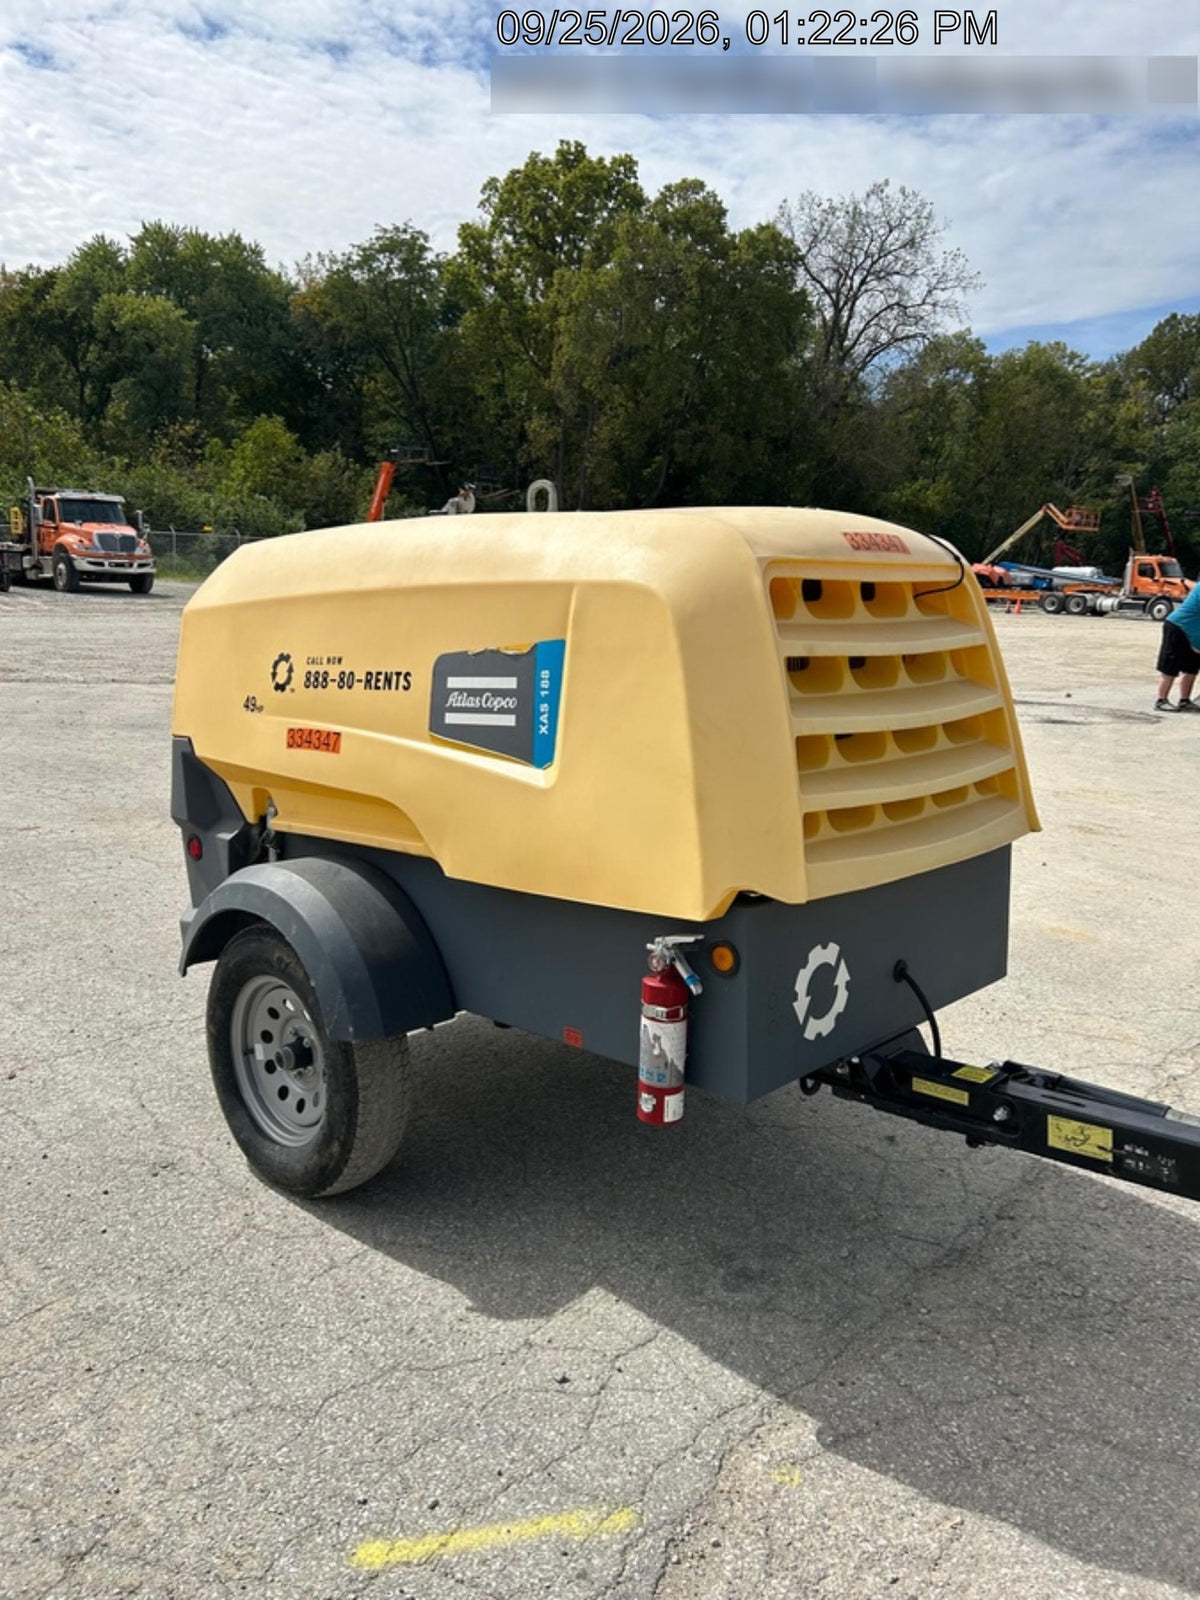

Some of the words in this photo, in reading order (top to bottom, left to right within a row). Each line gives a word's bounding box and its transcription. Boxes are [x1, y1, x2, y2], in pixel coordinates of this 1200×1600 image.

[306, 656, 324, 665] CALL
[326, 656, 342, 665] NOW
[303, 670, 411, 691] 888-80-RENTS
[540, 669, 550, 697] 188
[539, 703, 549, 735] XAS
[287, 728, 341, 752] 334347
